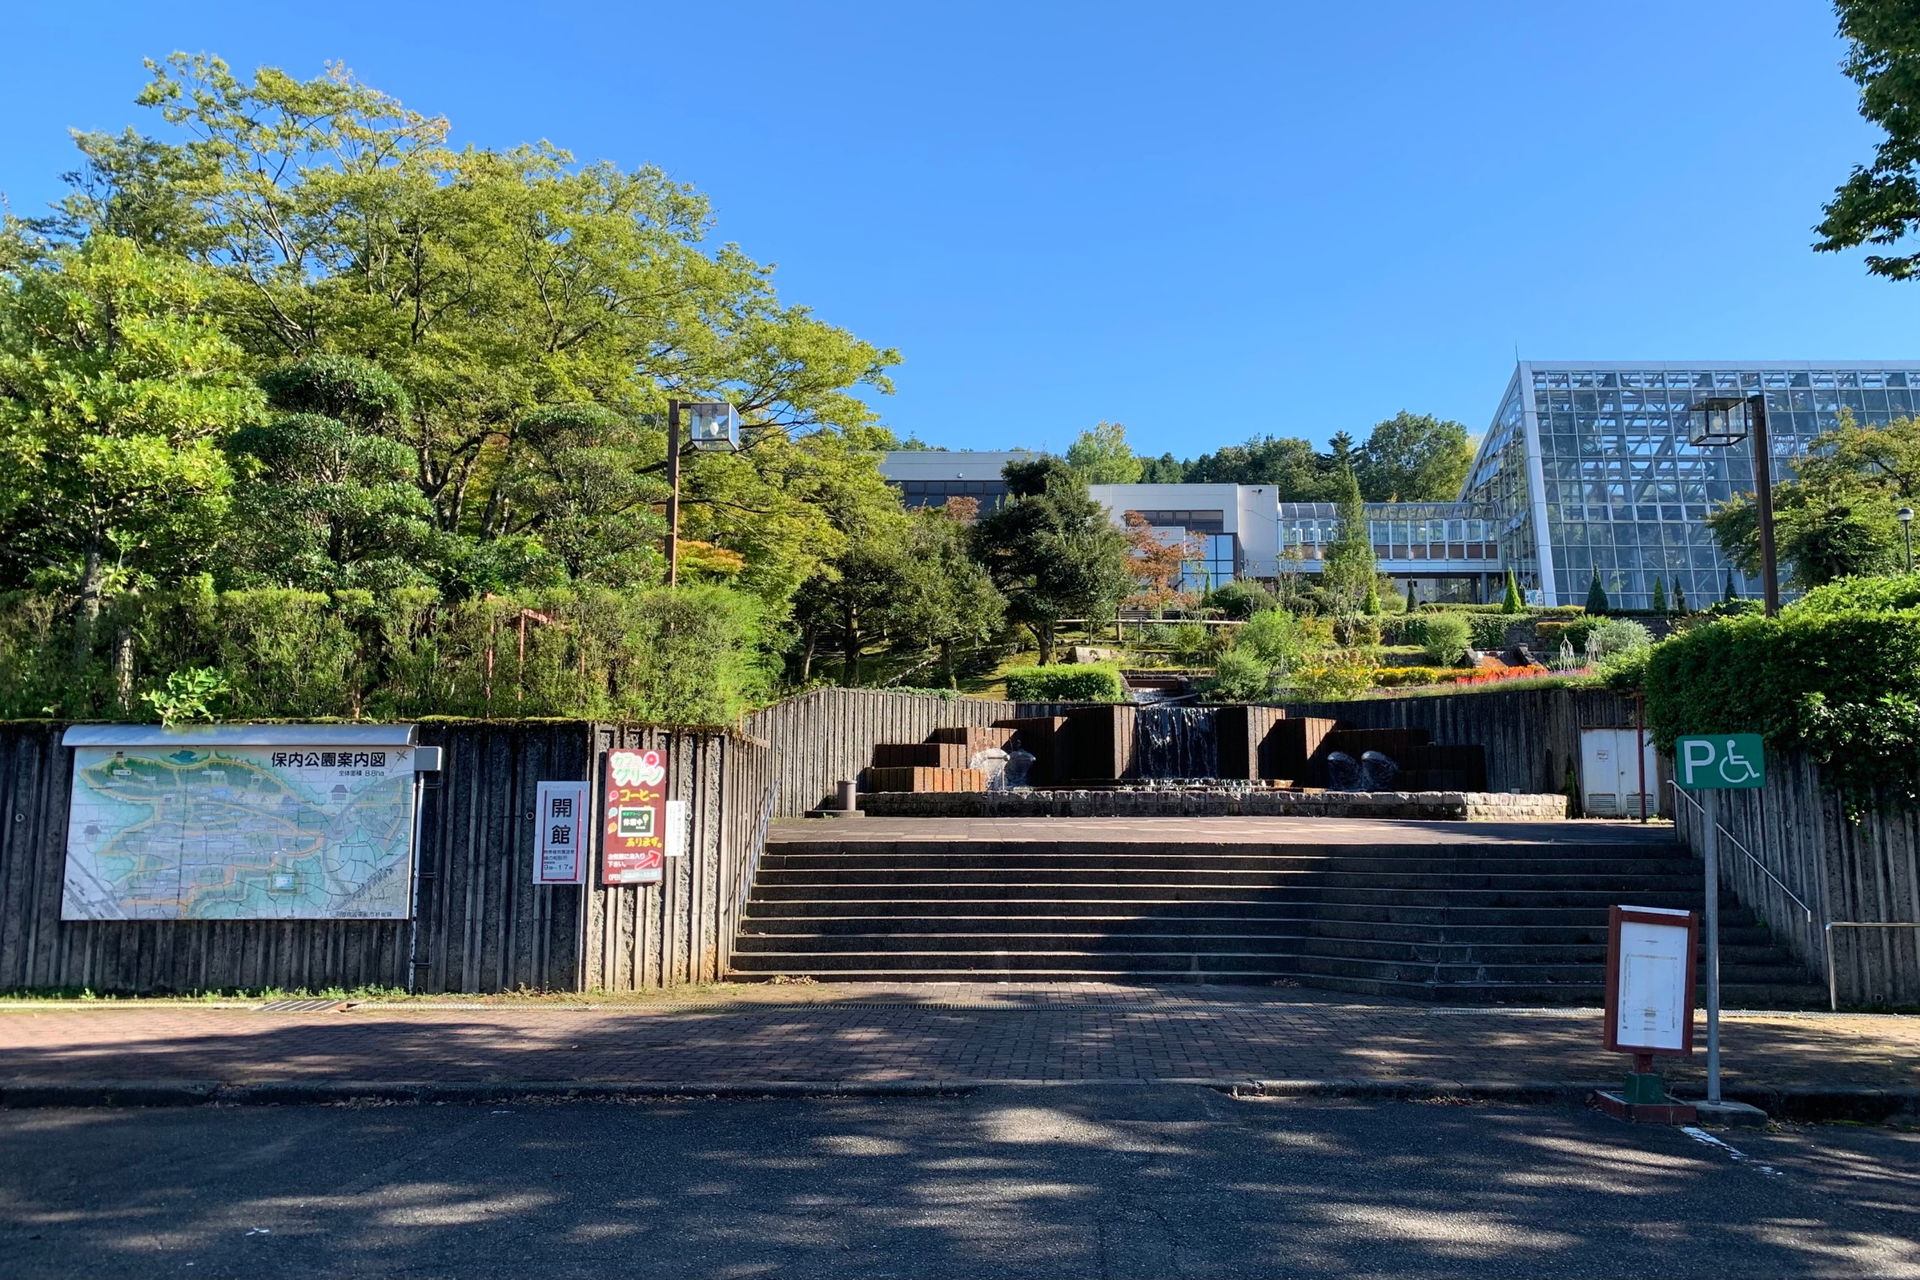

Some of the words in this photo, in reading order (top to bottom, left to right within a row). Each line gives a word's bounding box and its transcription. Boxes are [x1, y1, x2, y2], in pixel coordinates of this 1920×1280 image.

[271, 752, 386, 768] 保内公園案内図
[1684, 740, 1716, 784] P
[619, 789, 660, 801] コーヒー
[551, 798, 572, 845] 開館
